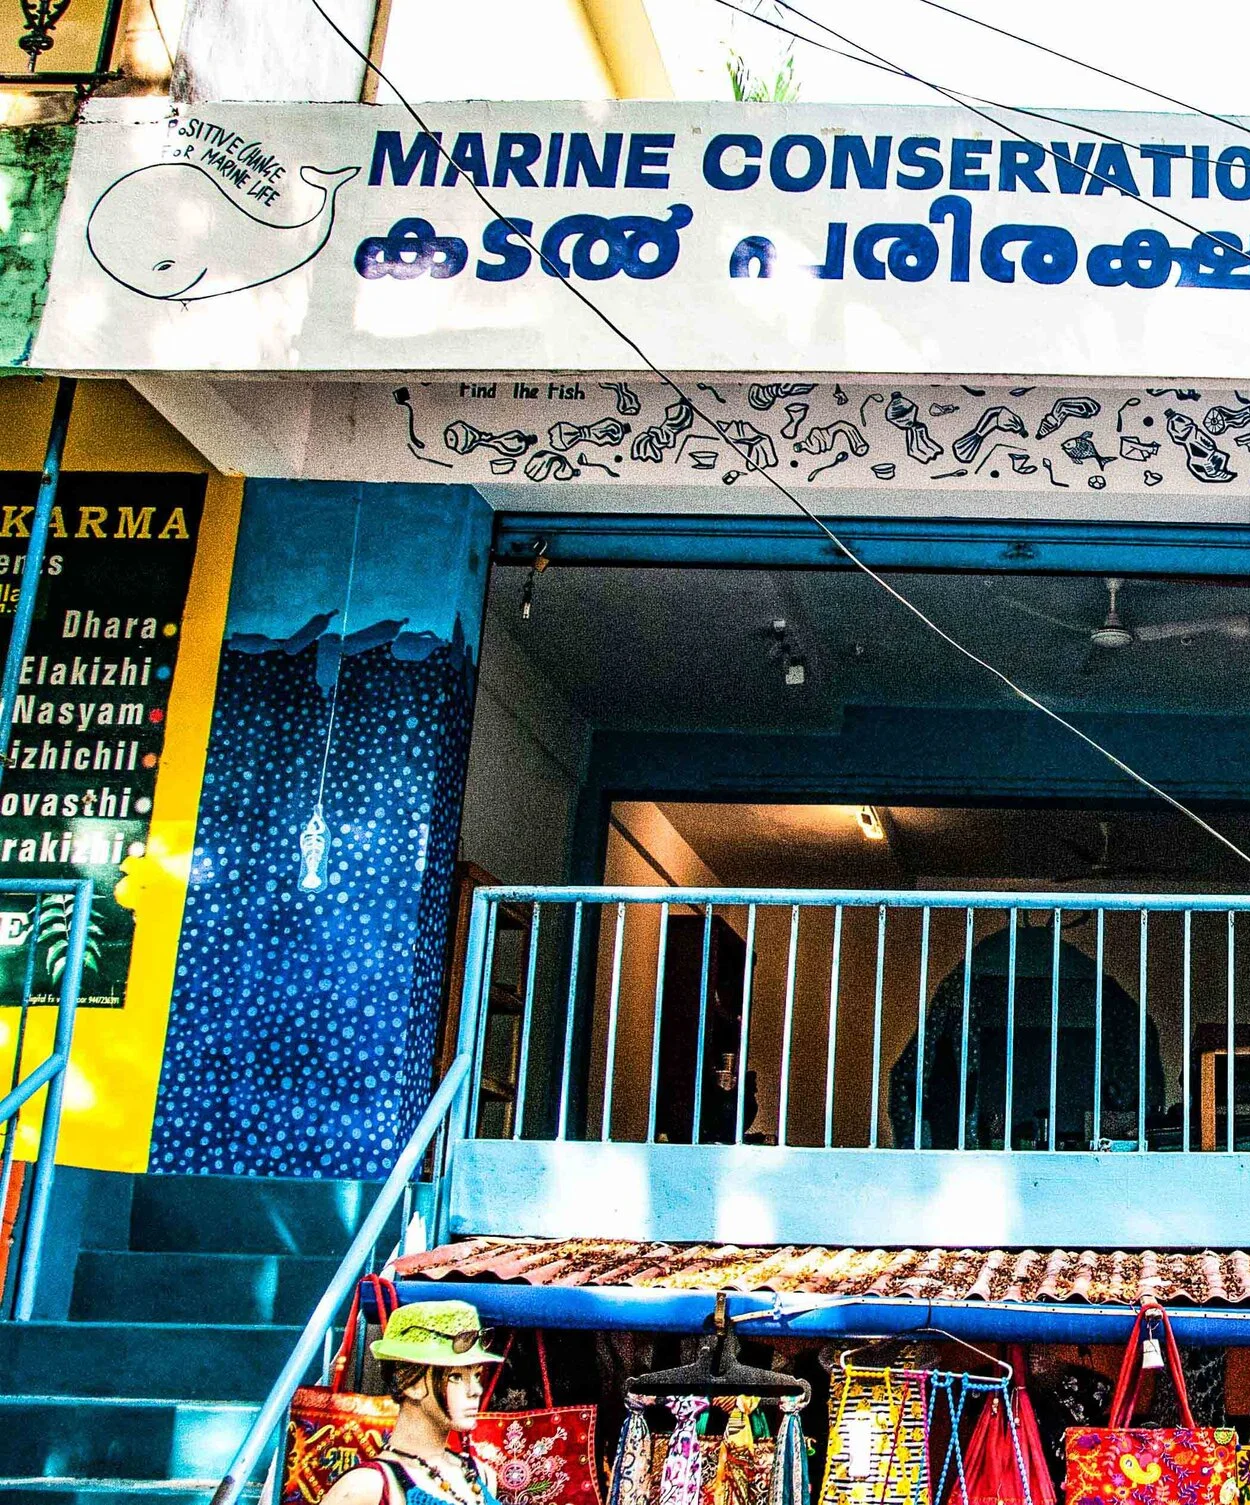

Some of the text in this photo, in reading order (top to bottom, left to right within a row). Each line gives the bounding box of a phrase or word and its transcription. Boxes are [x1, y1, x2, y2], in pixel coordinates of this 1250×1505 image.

[200, 148, 251, 189] MARINE
[247, 180, 281, 207] LIFE
[368, 130, 675, 190] MARINE
[0, 505, 190, 540] KARMA
[62, 610, 157, 639] Dhara
[19, 656, 152, 686] Elakizhi
[11, 695, 145, 732] Nasyam
